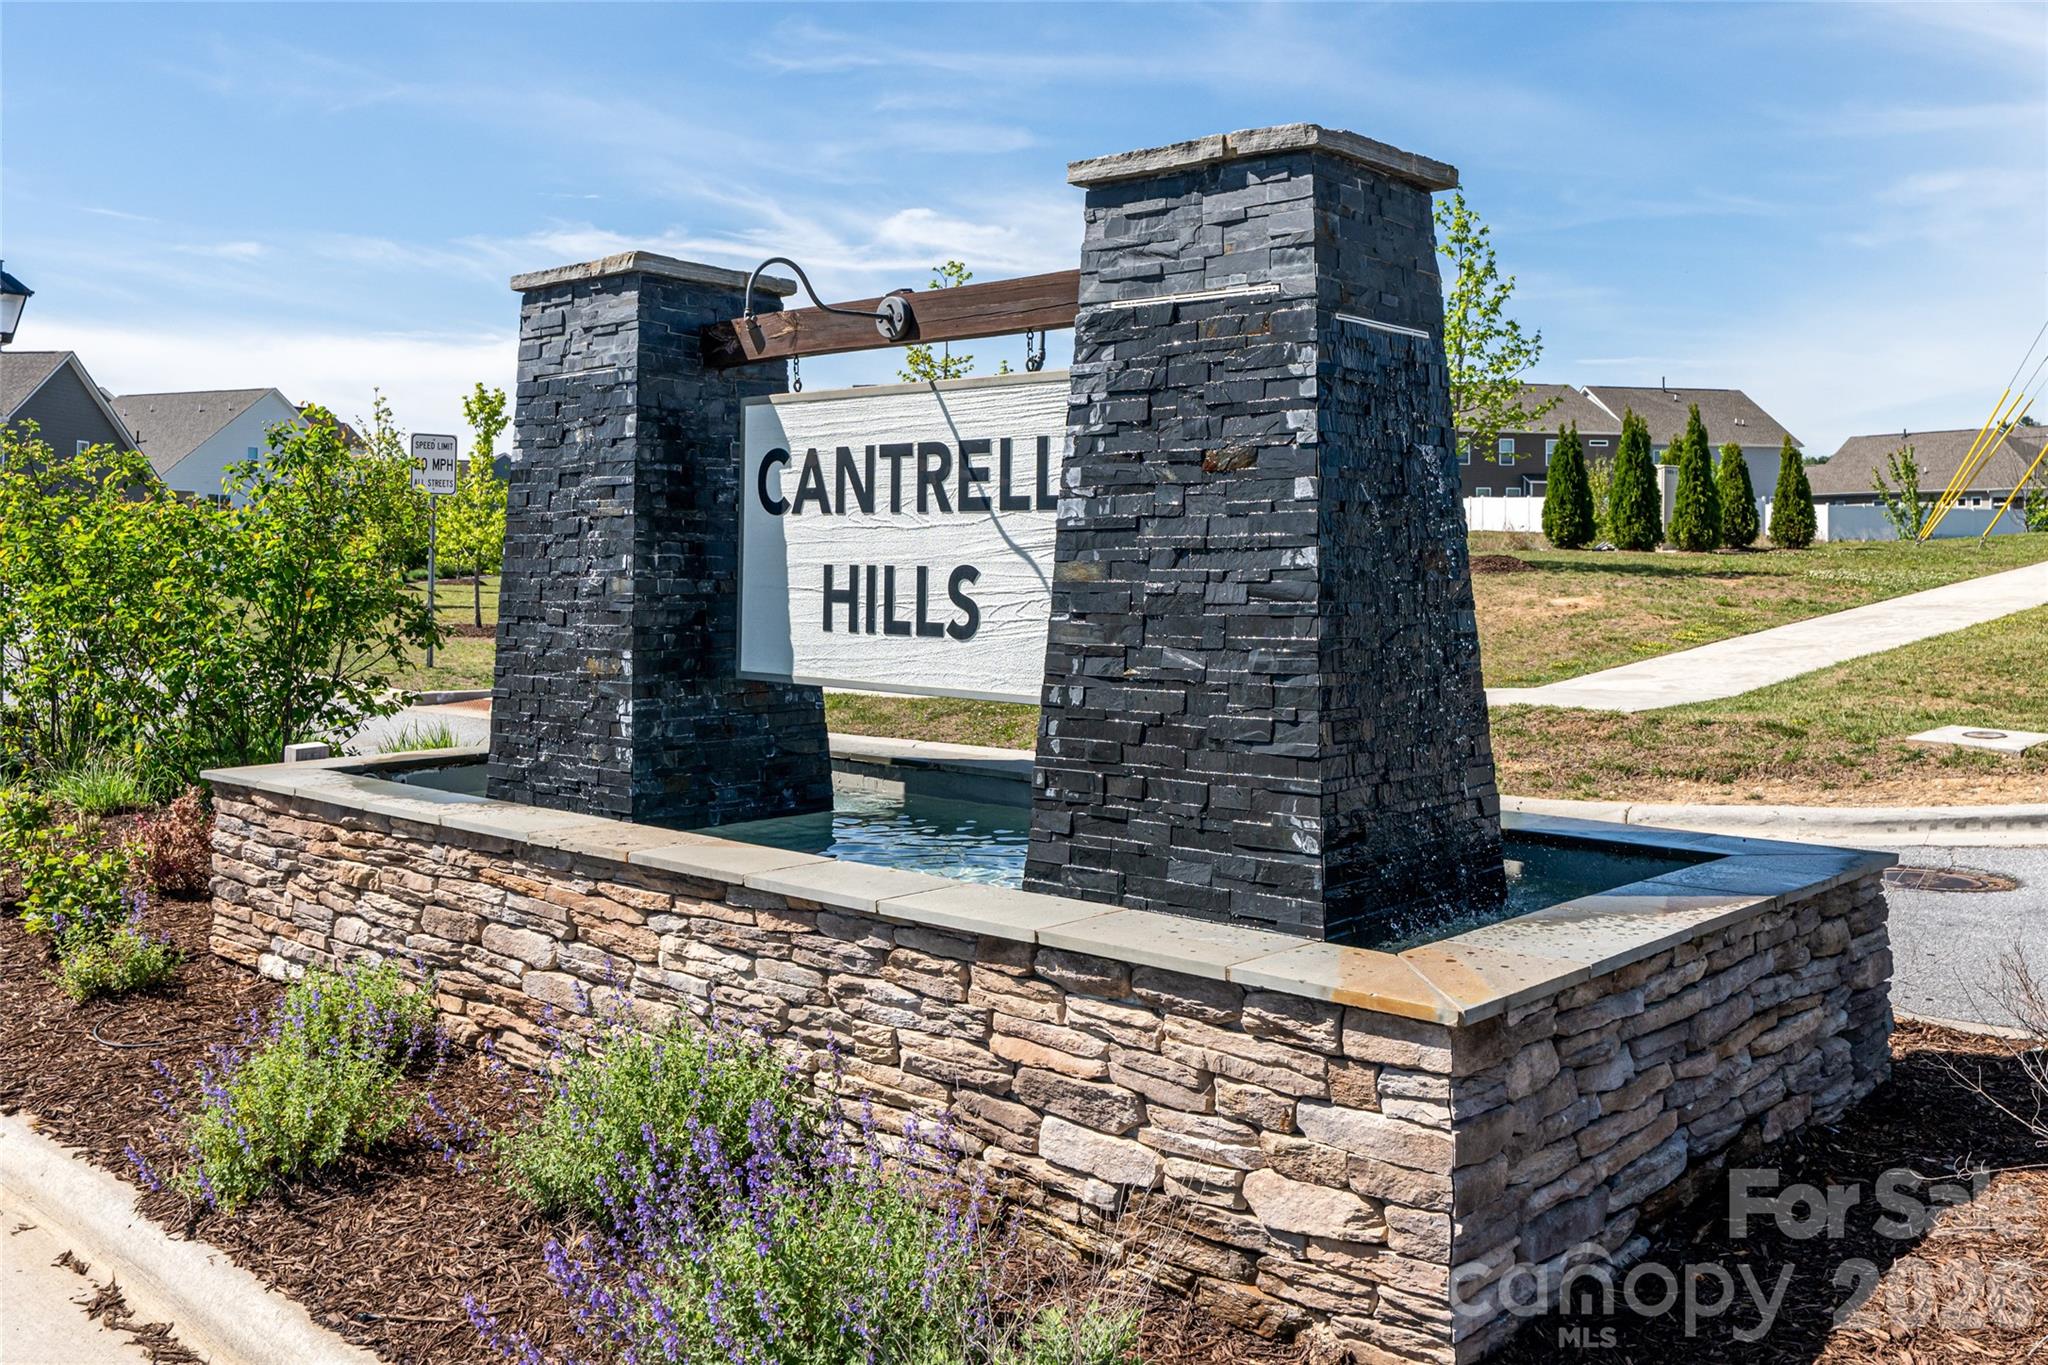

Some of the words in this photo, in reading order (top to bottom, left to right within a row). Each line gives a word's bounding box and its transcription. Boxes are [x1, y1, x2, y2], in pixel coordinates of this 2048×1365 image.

[415, 441, 435, 450] SPEED
[437, 442, 453, 451] LIMIT
[432, 458, 453, 472] MPH
[758, 435, 1059, 516] CANTRELL
[427, 478, 454, 488] STREETS
[823, 564, 981, 641] HILLS
